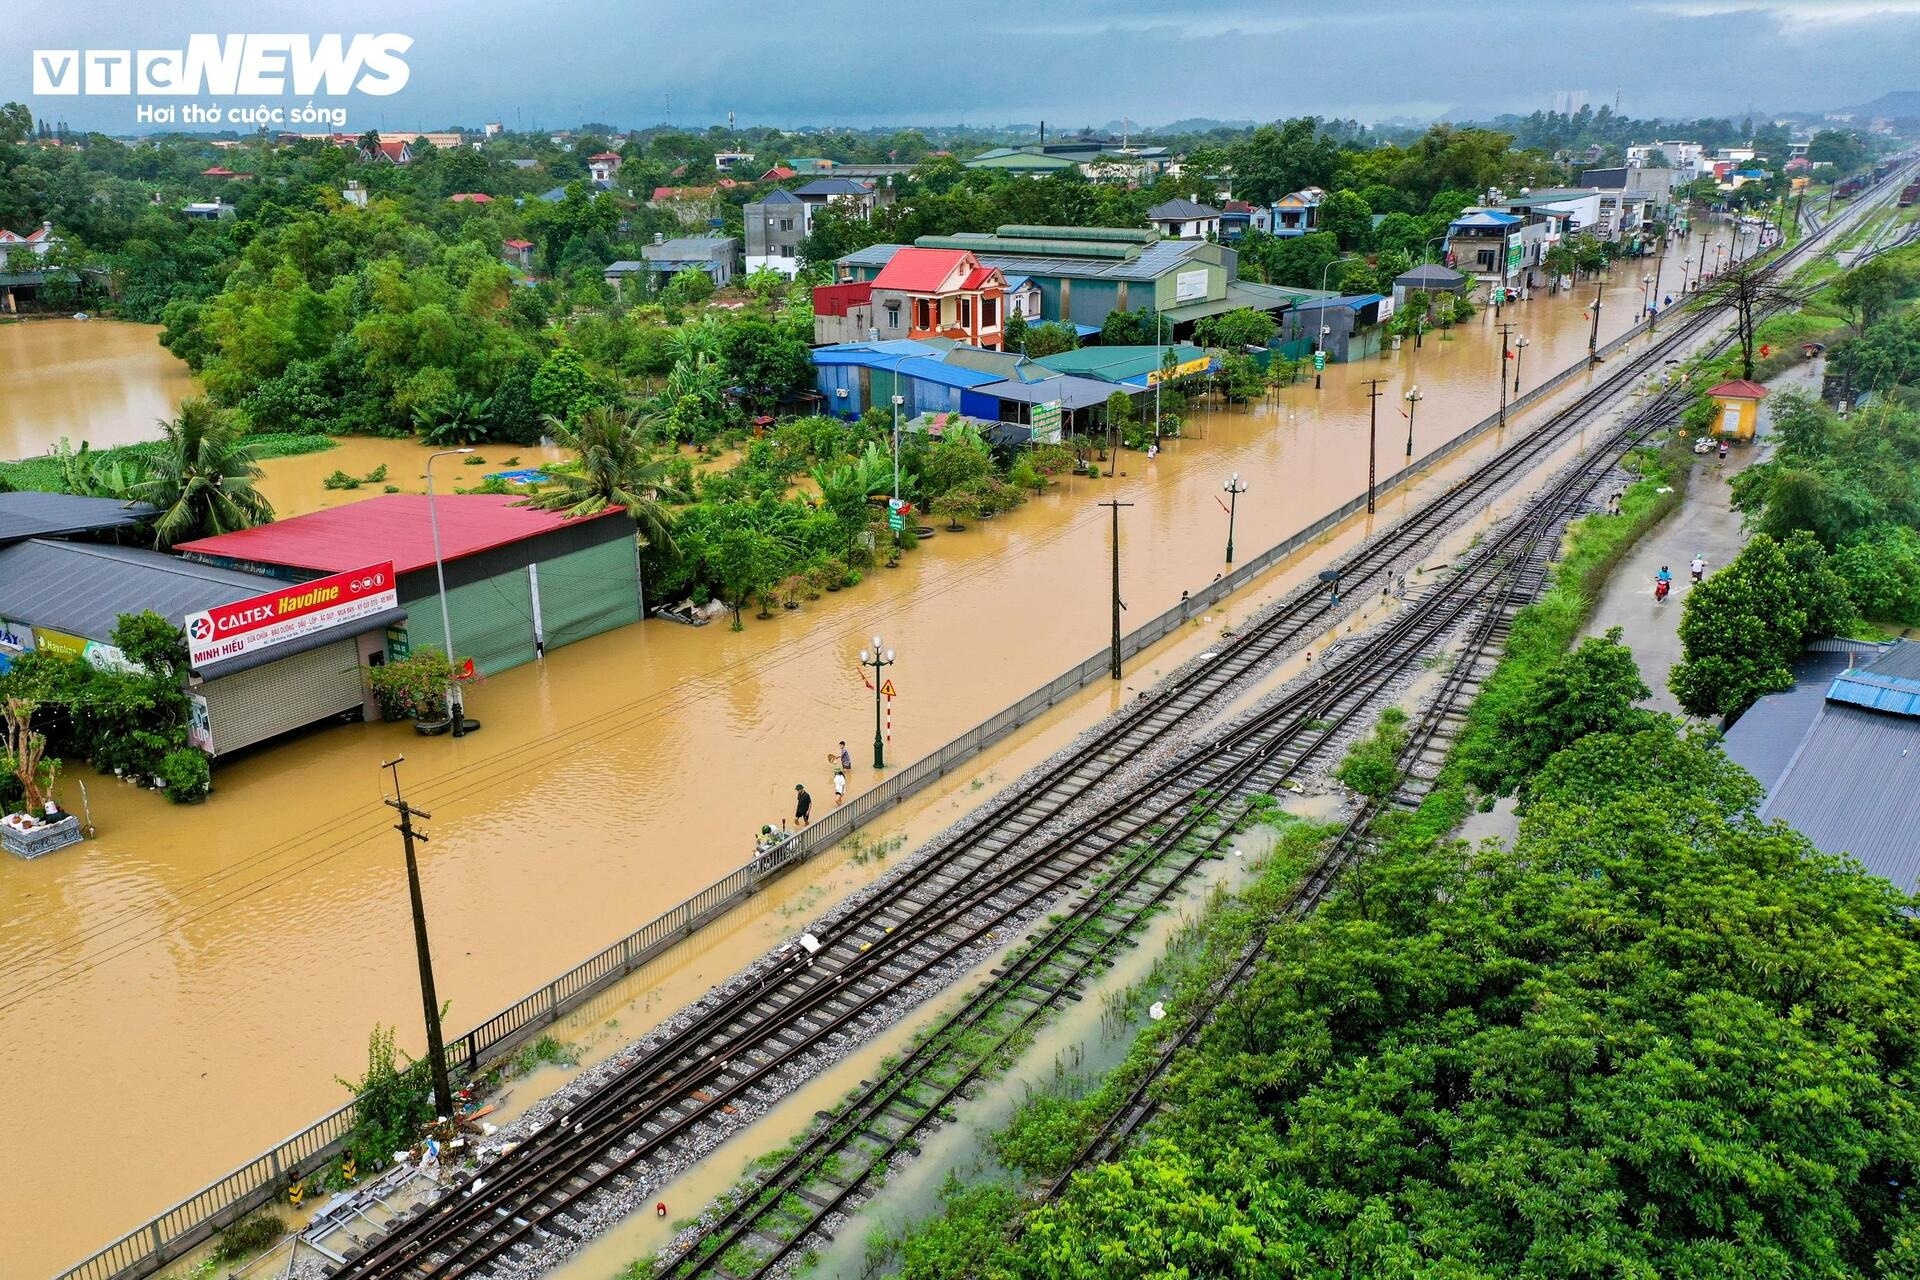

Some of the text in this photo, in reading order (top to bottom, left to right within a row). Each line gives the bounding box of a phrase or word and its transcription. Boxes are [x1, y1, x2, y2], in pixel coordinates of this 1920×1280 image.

[218, 585, 339, 630] CALTEX Havoline
[194, 638, 243, 663] MINH HIẾU
